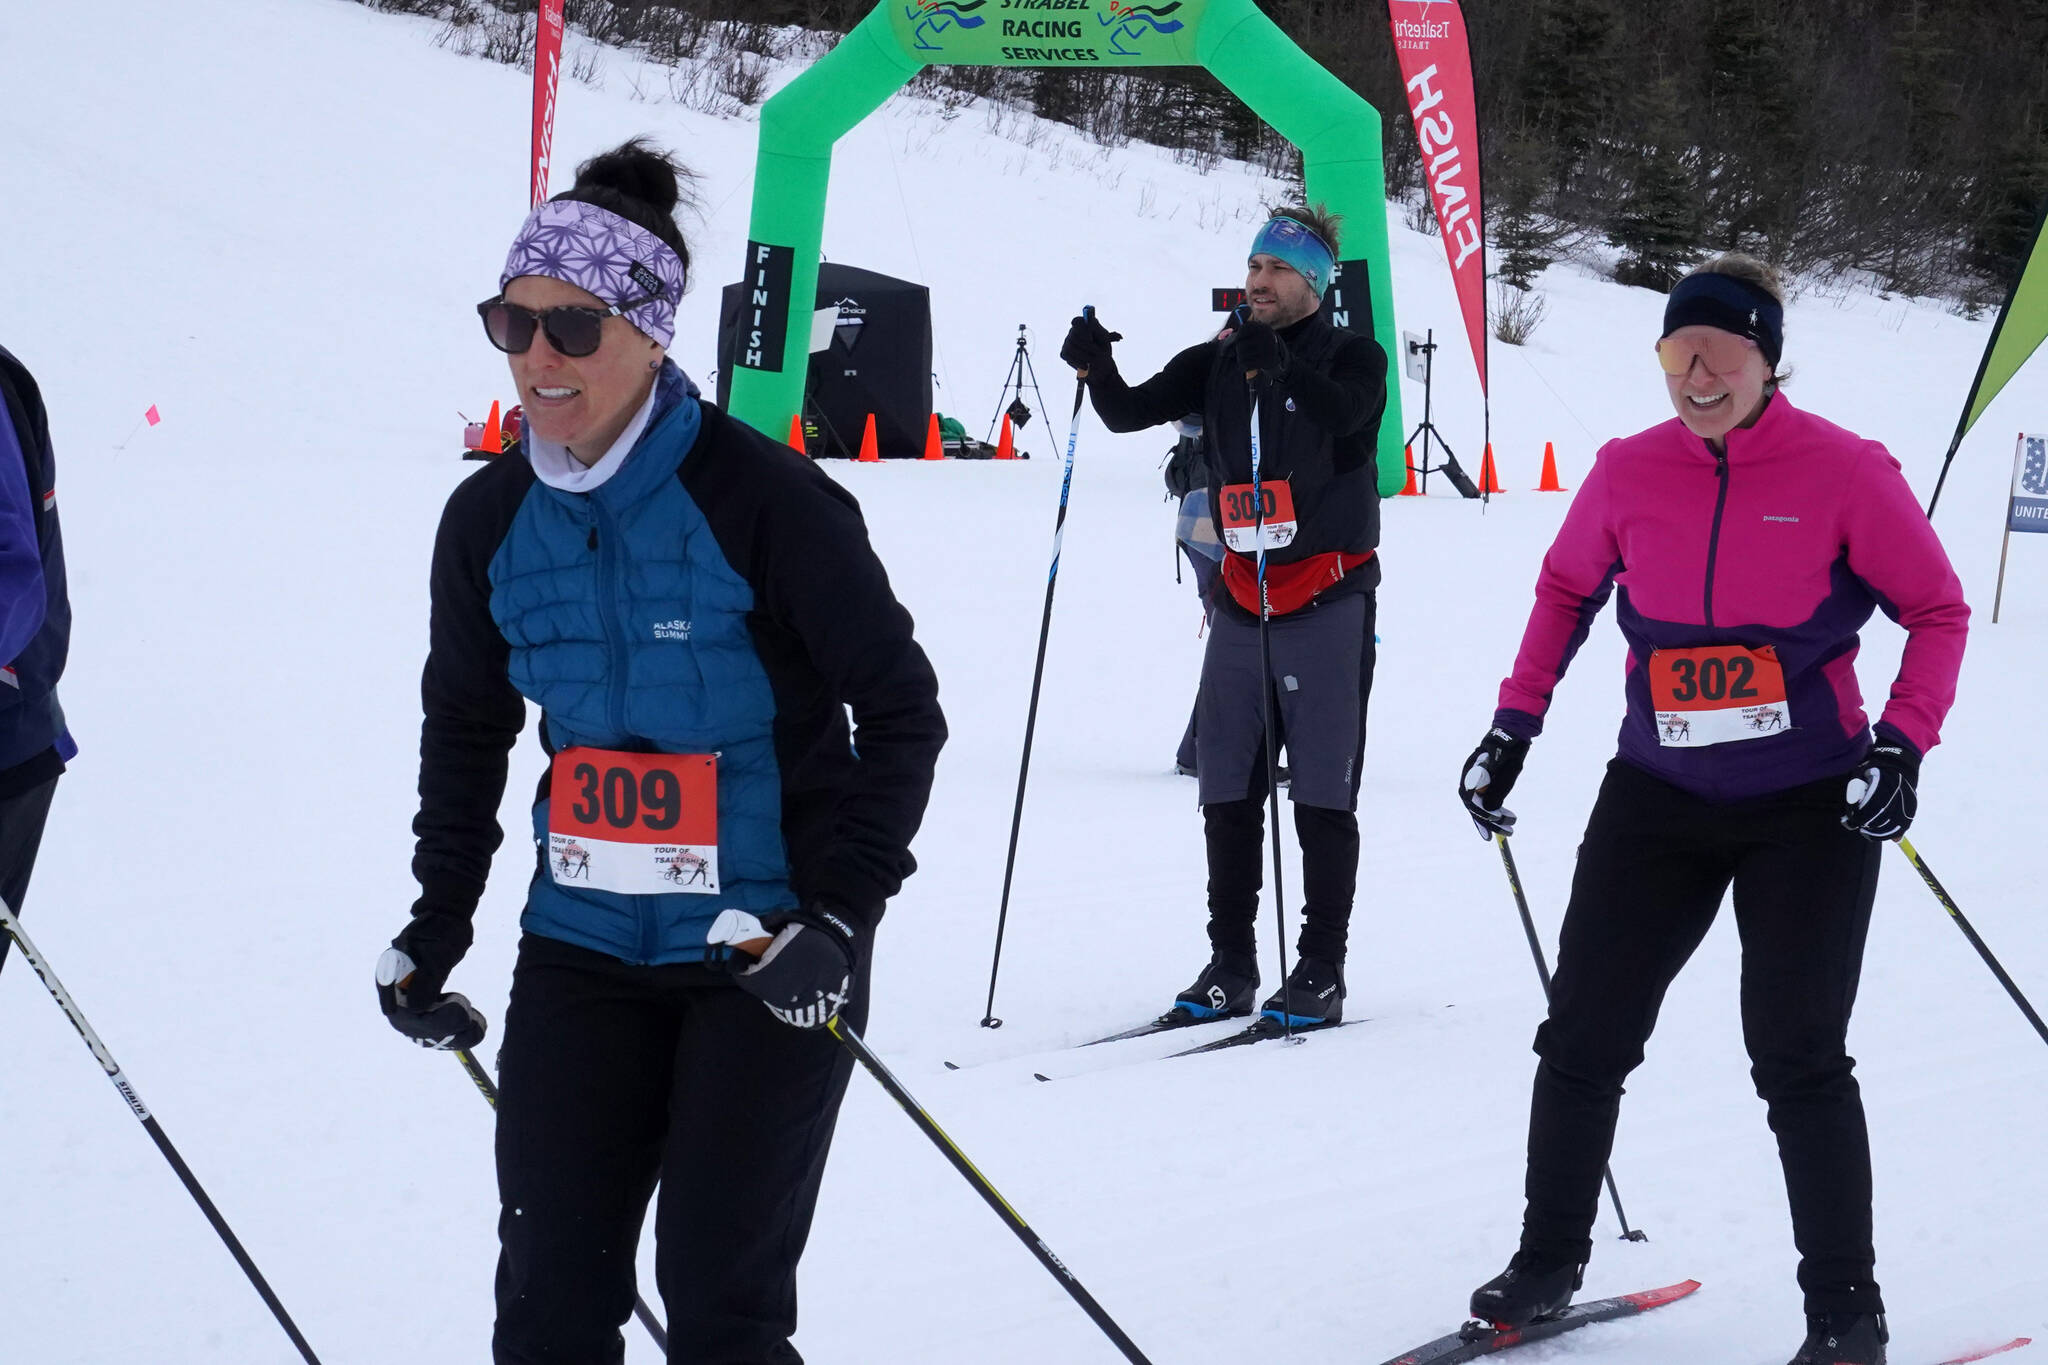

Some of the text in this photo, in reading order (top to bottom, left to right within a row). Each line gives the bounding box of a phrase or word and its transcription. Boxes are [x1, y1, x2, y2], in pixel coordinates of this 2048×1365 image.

[1002, 19, 1082, 38] RACING
[1002, 46, 1100, 61] SERVICES
[745, 245, 771, 367] FINISH
[1329, 264, 1349, 328] FIN
[1226, 488, 1276, 522] 300
[654, 630, 690, 641] SUMMI
[1671, 656, 1758, 702] 302
[572, 762, 681, 832] 309
[551, 836, 577, 846] TOUR OF
[654, 847, 690, 855] TOUR OF
[654, 856, 700, 864] TSALTESHI
[119, 1081, 146, 1114] STEALTH
